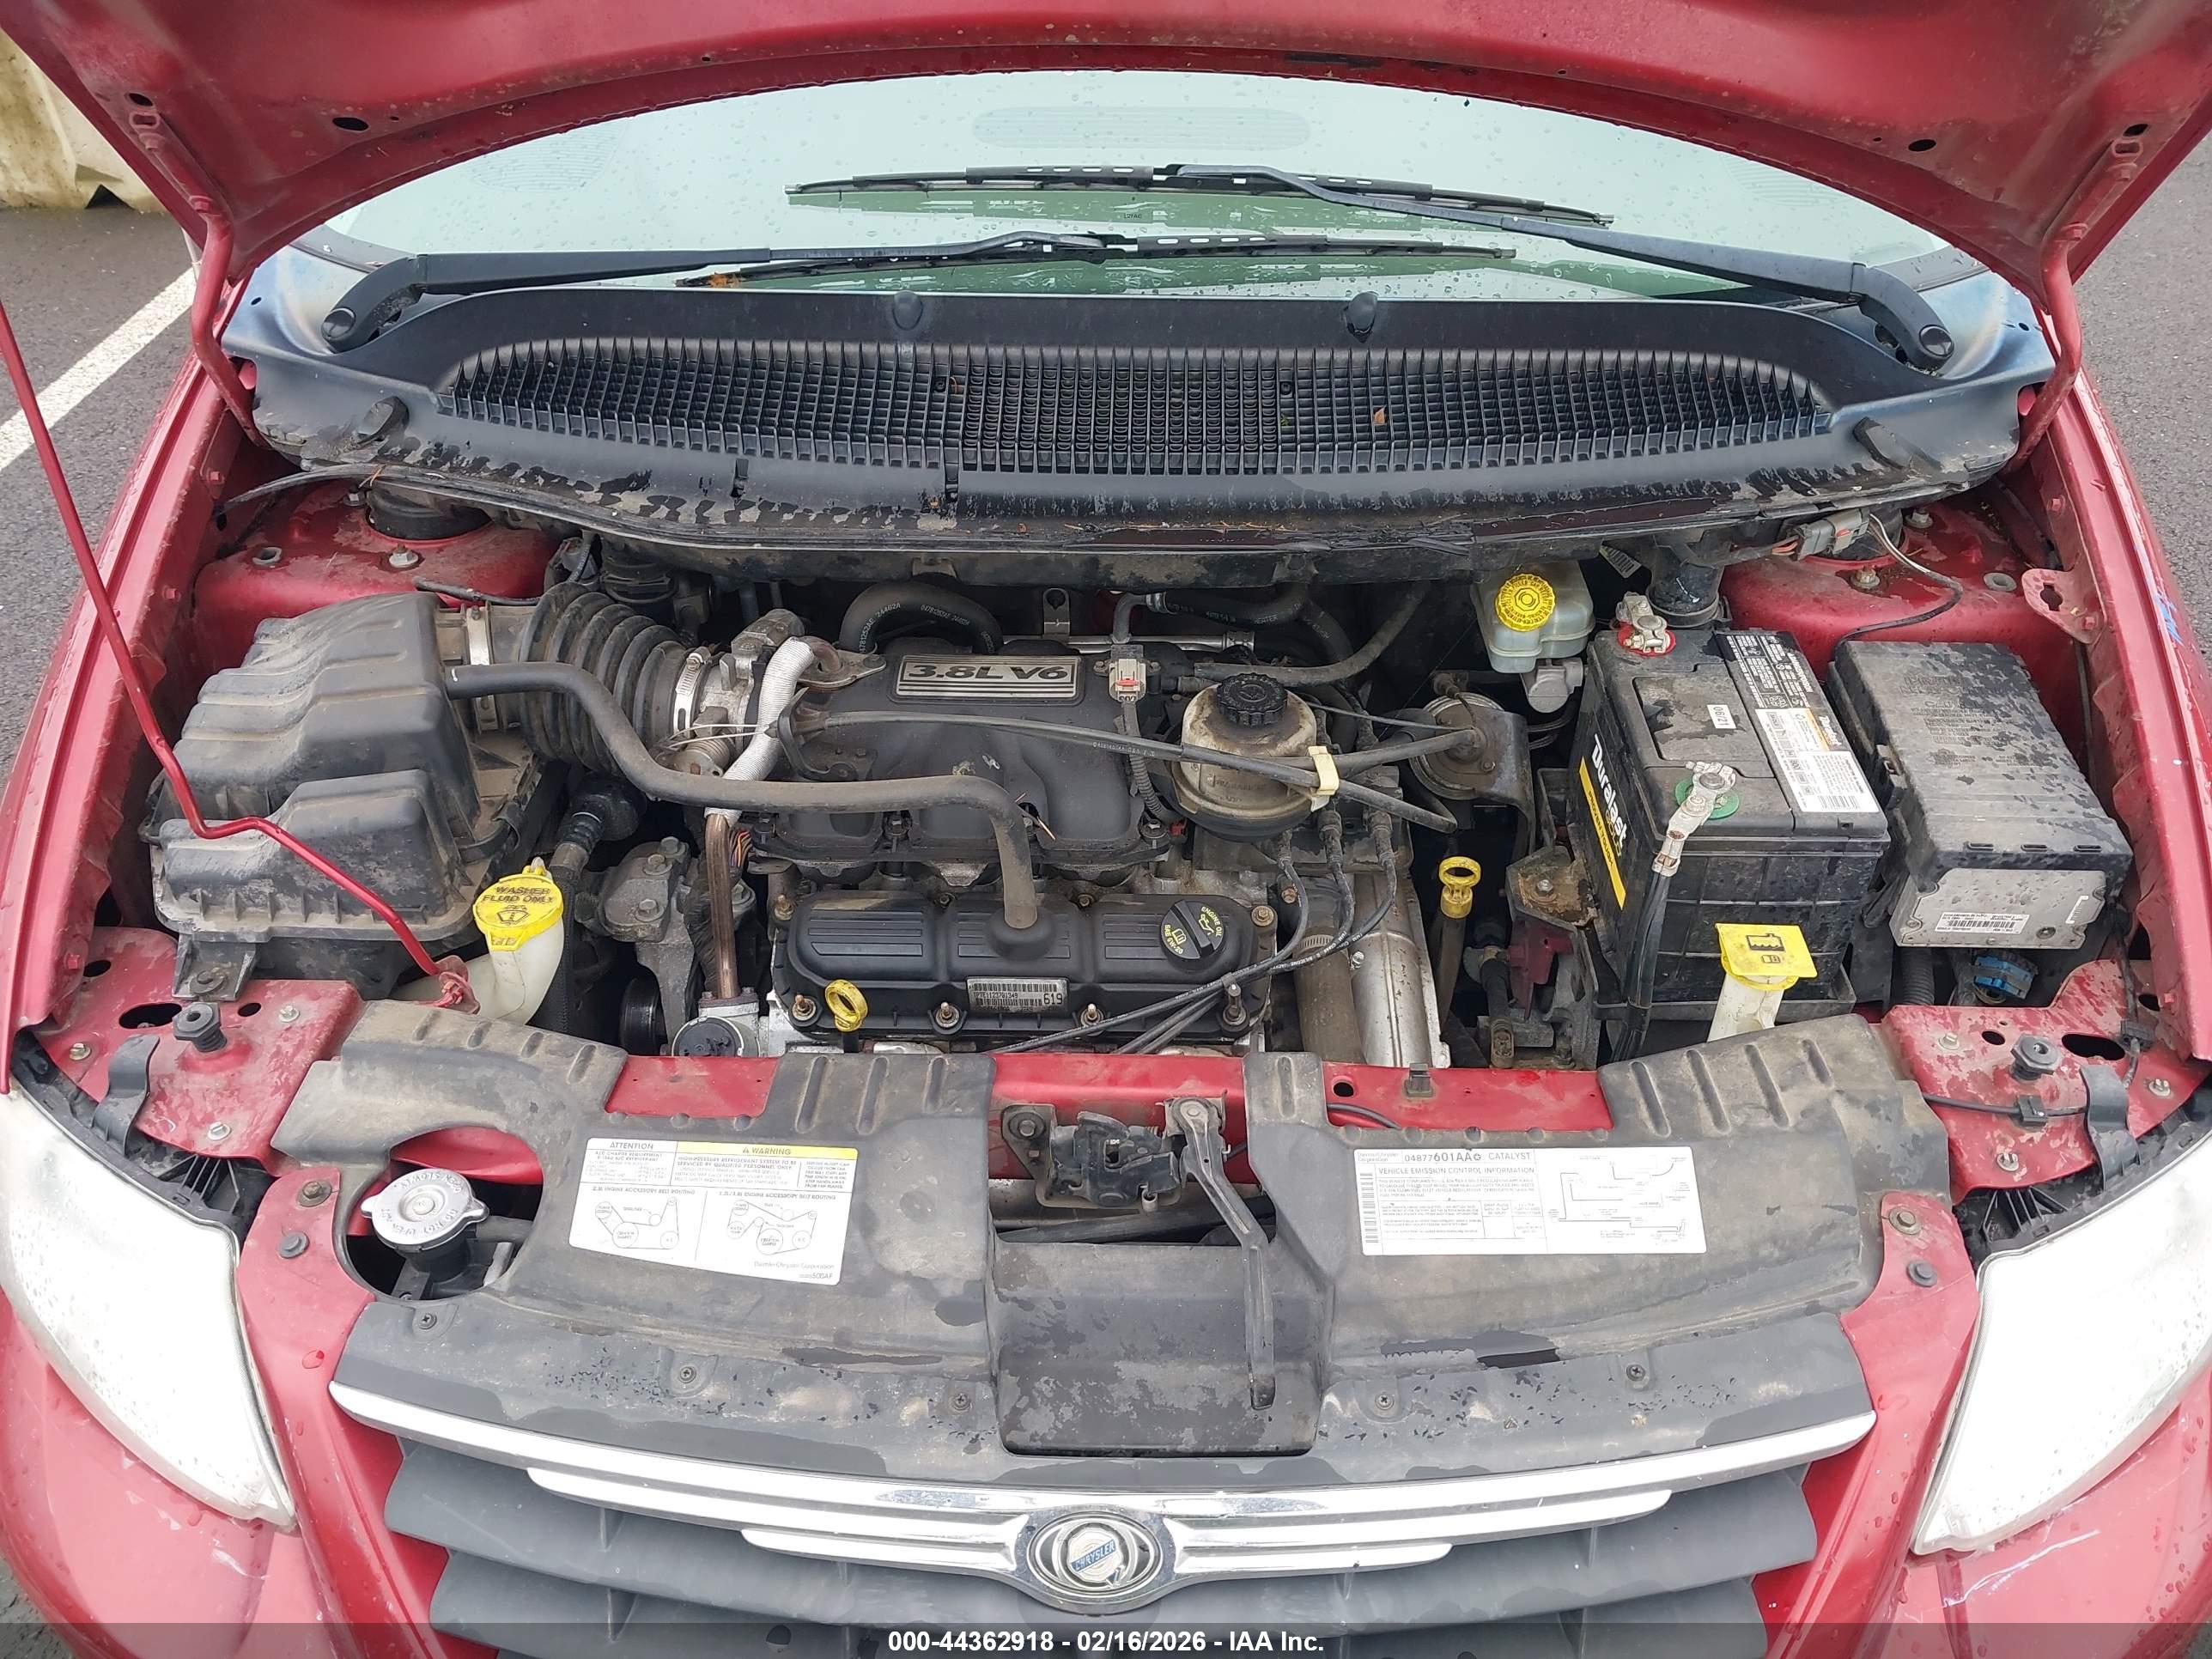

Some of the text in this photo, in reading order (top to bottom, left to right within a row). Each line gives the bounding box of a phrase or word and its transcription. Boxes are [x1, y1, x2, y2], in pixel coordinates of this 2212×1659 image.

[908, 665, 1068, 680] 3.8L V6
[1712, 706, 1729, 726] 06/21
[1592, 733, 1627, 849] Duralast
[1589, 790, 1601, 833] PROVEN
[1605, 809, 1621, 857] GOLD
[523, 895, 553, 904] ONLY
[1201, 907, 1220, 926] ENGINE
[1167, 938, 1183, 954] 5W-20
[1043, 993, 1063, 1005] 619
[751, 1147, 791, 1156] WARNING
[1075, 1540, 1115, 1571] CHRYSLER
